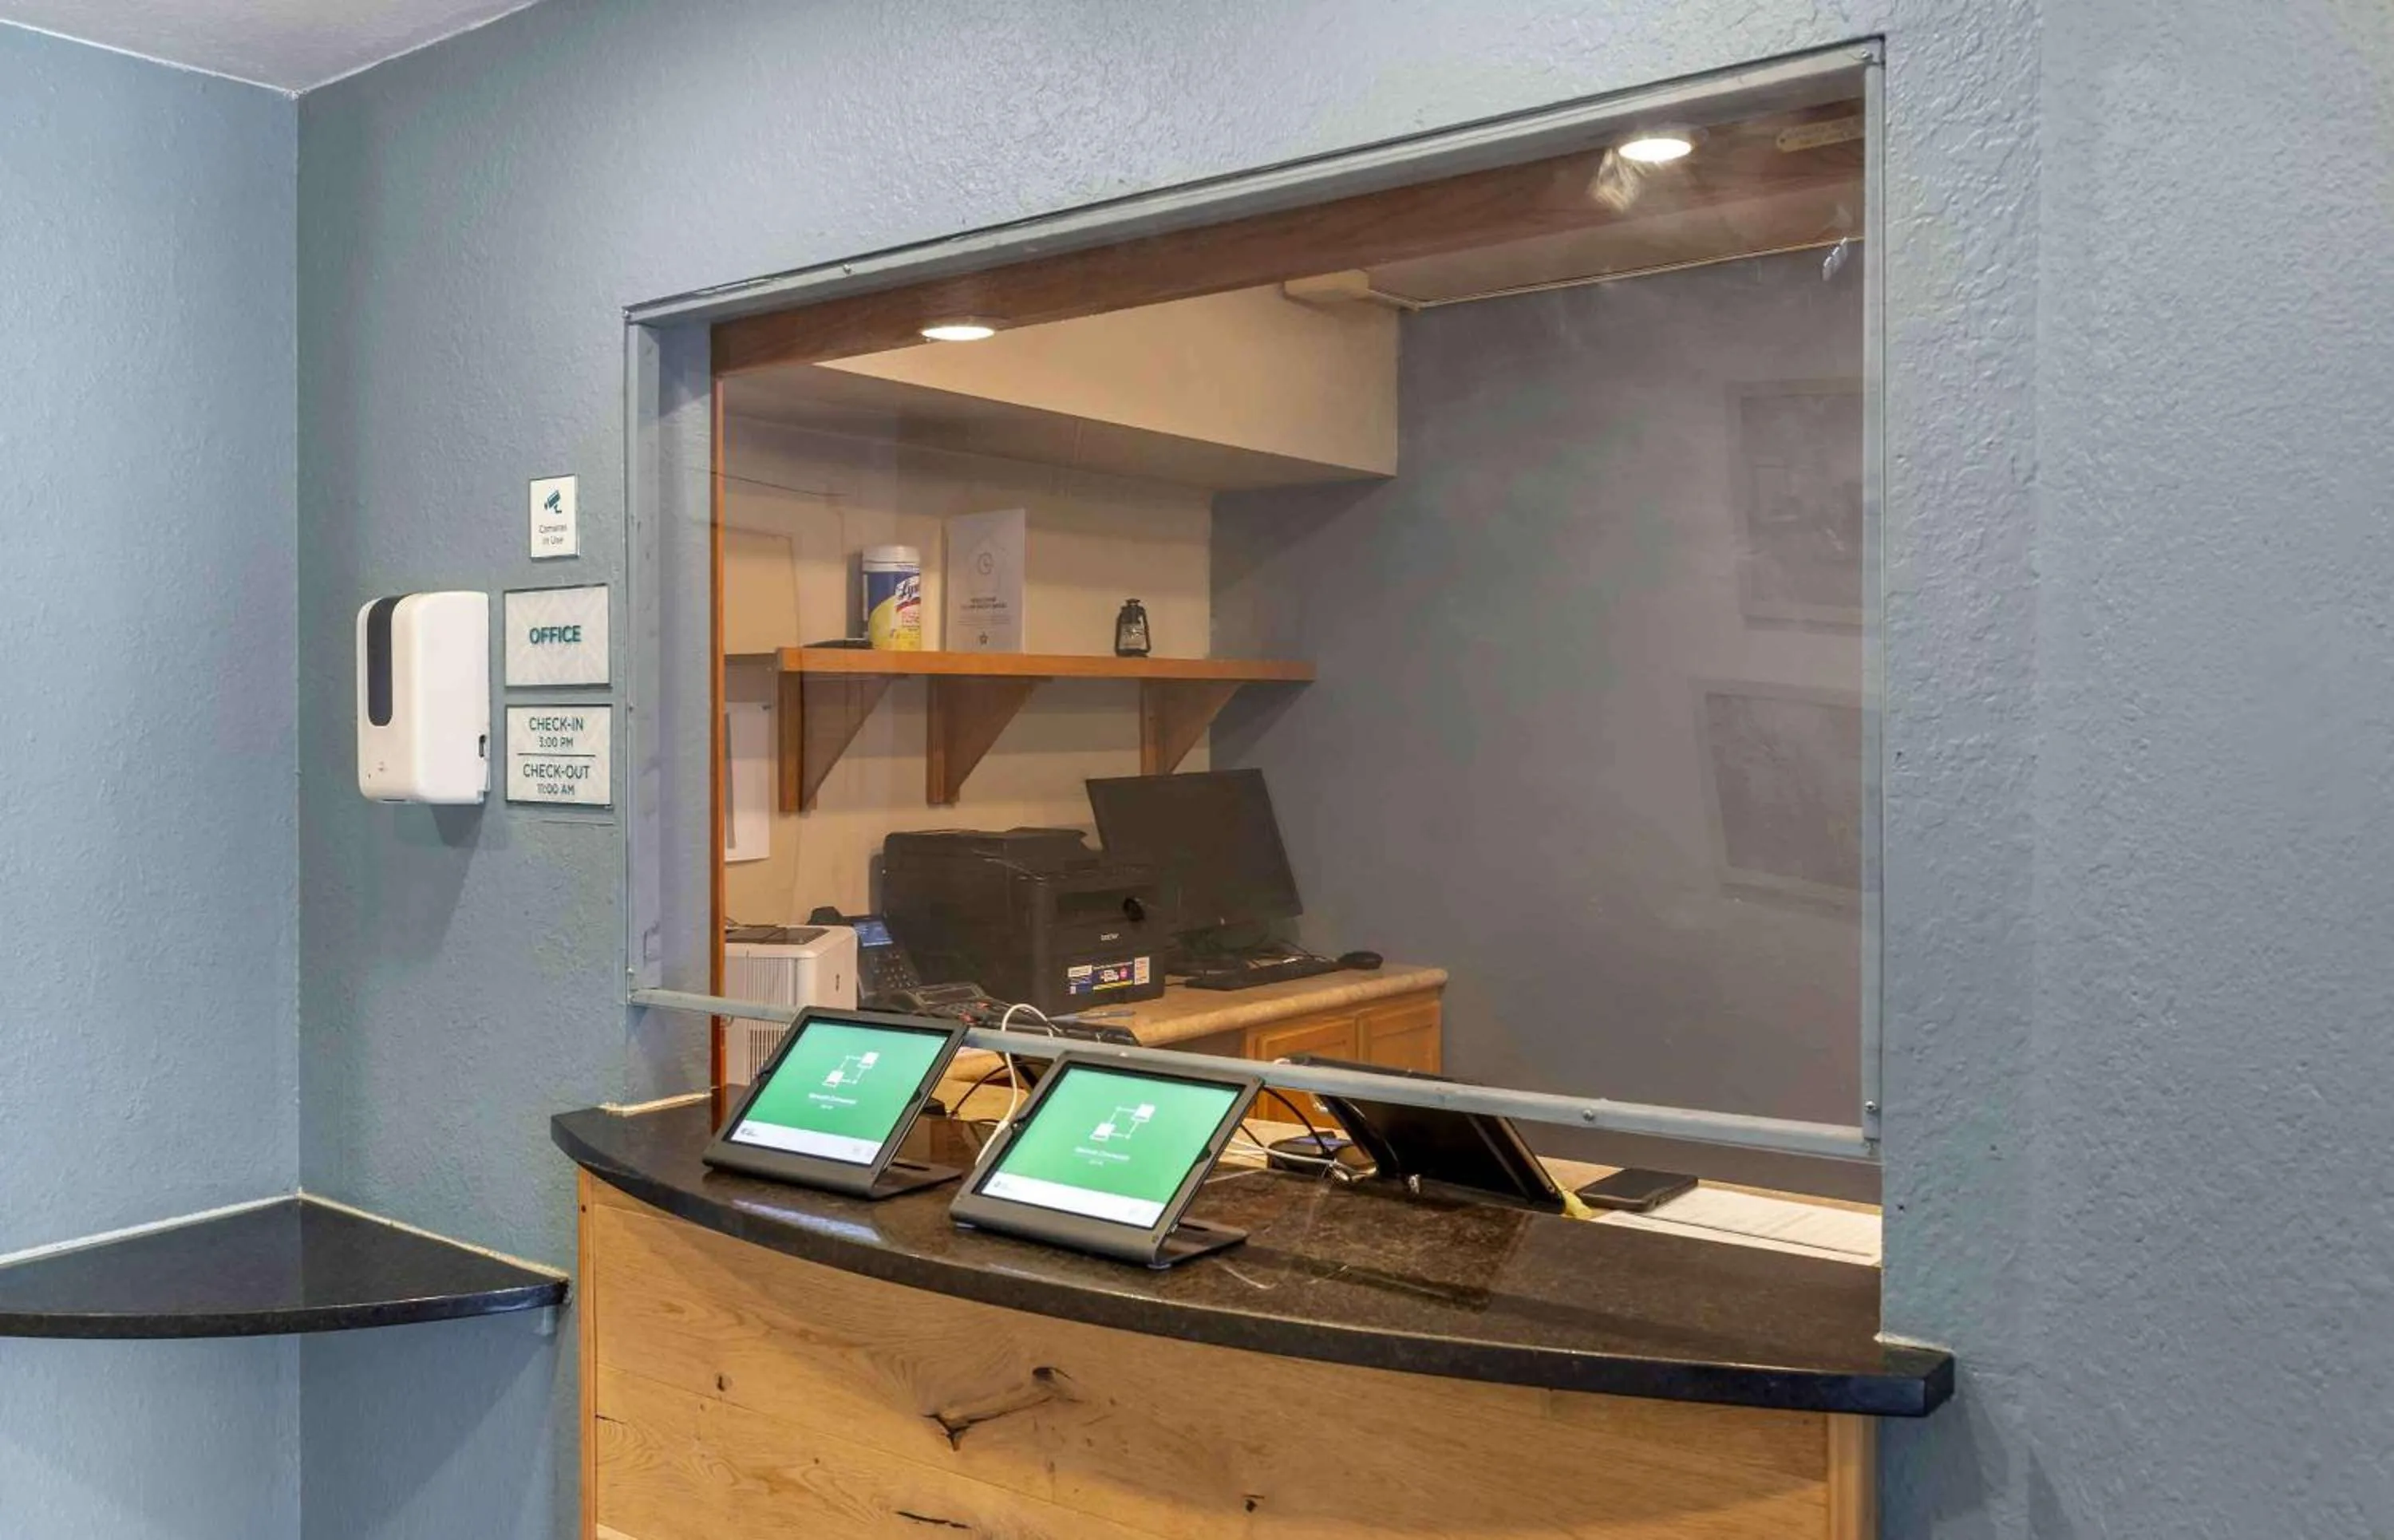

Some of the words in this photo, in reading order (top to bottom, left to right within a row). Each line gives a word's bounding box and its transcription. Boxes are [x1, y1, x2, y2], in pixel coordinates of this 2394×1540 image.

[529, 625, 581, 644] OFFICE
[529, 717, 583, 732] CHECK-IN
[539, 736, 558, 748] 3:00
[560, 736, 573, 747] PM
[523, 764, 591, 779] CHECK-OUT
[561, 784, 575, 795] AM
